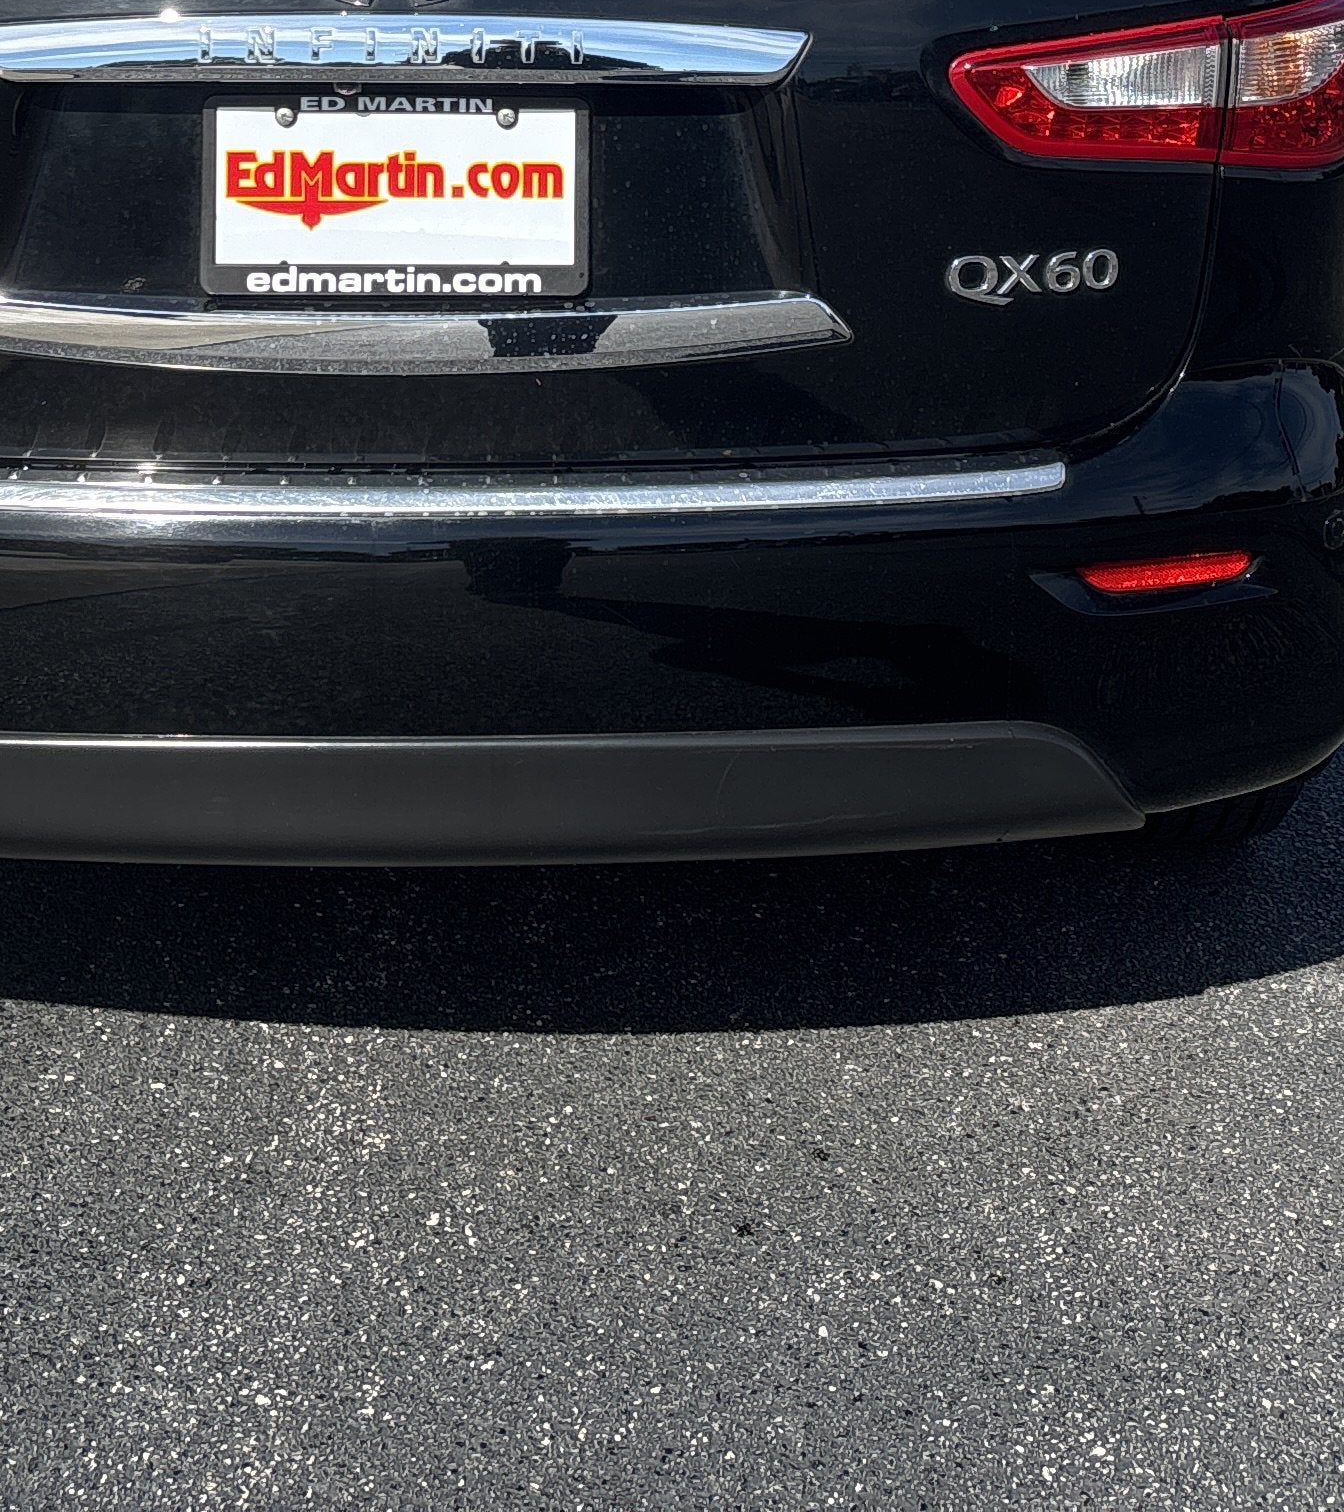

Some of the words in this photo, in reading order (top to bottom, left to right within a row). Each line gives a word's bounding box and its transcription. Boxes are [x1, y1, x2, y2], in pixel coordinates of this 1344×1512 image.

[197, 26, 585, 65] INFINITI
[299, 96, 352, 112] ED
[356, 97, 494, 113] MARTIN
[246, 265, 543, 294] edmartin.com
[946, 248, 1119, 306] QX60
